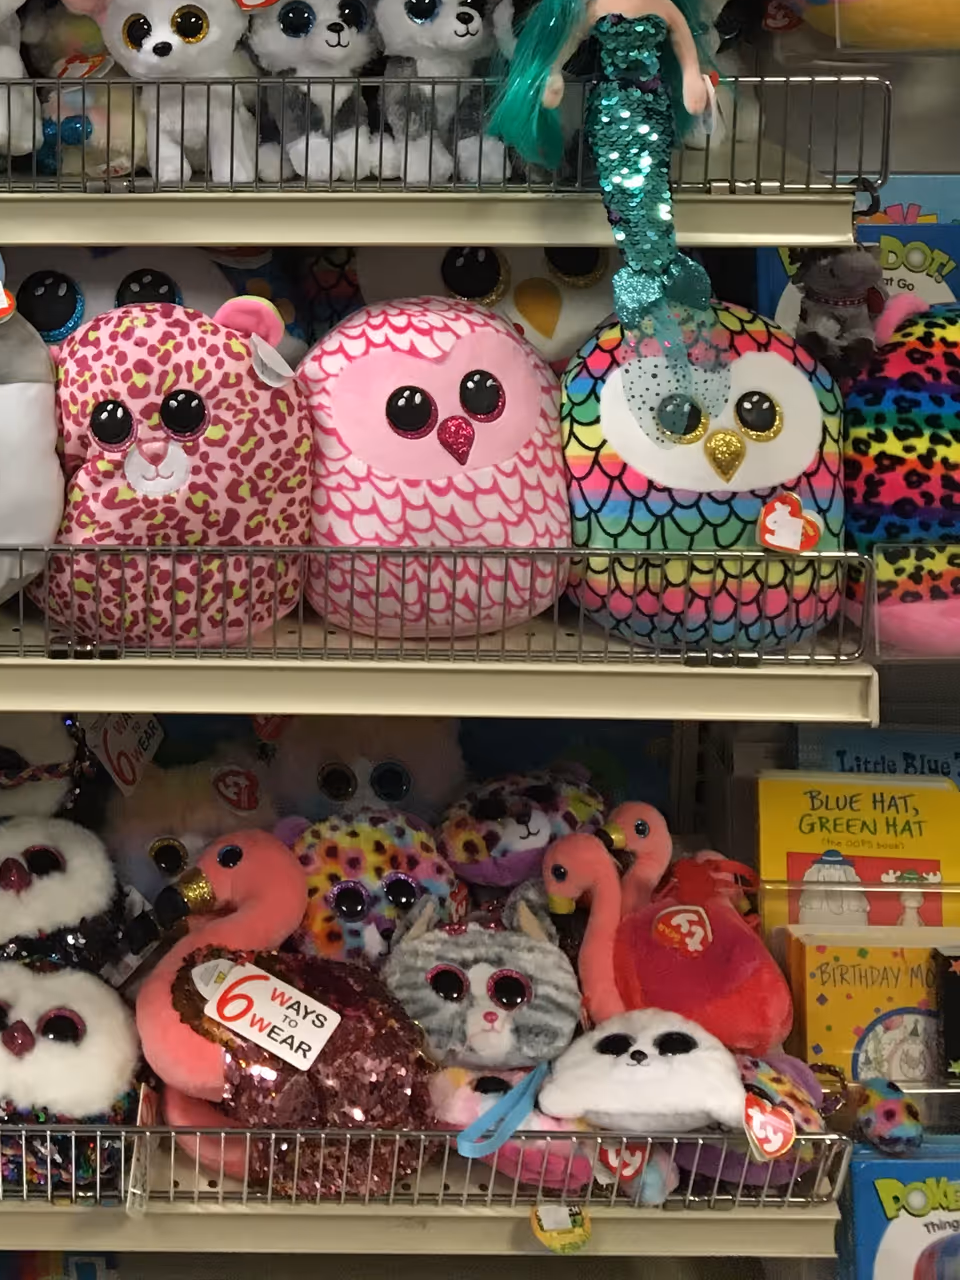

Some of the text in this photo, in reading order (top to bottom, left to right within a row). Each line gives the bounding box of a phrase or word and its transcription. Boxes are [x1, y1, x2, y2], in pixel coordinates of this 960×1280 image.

[897, 278, 915, 292] Go
[836, 750, 897, 774] Little
[903, 751, 951, 776] Blue
[219, 776, 249, 800] ty
[804, 789, 919, 817] BLUE HAT,
[798, 813, 928, 838] GREEN HAT
[671, 913, 704, 952] ty
[816, 962, 900, 990] BIRTHDAY
[216, 974, 270, 1023] 6
[271, 987, 328, 1029] WAYS
[249, 997, 312, 1060] WEAR
[282, 1014, 299, 1029] TO
[747, 1106, 784, 1152] ty
[607, 1146, 643, 1177] ty
